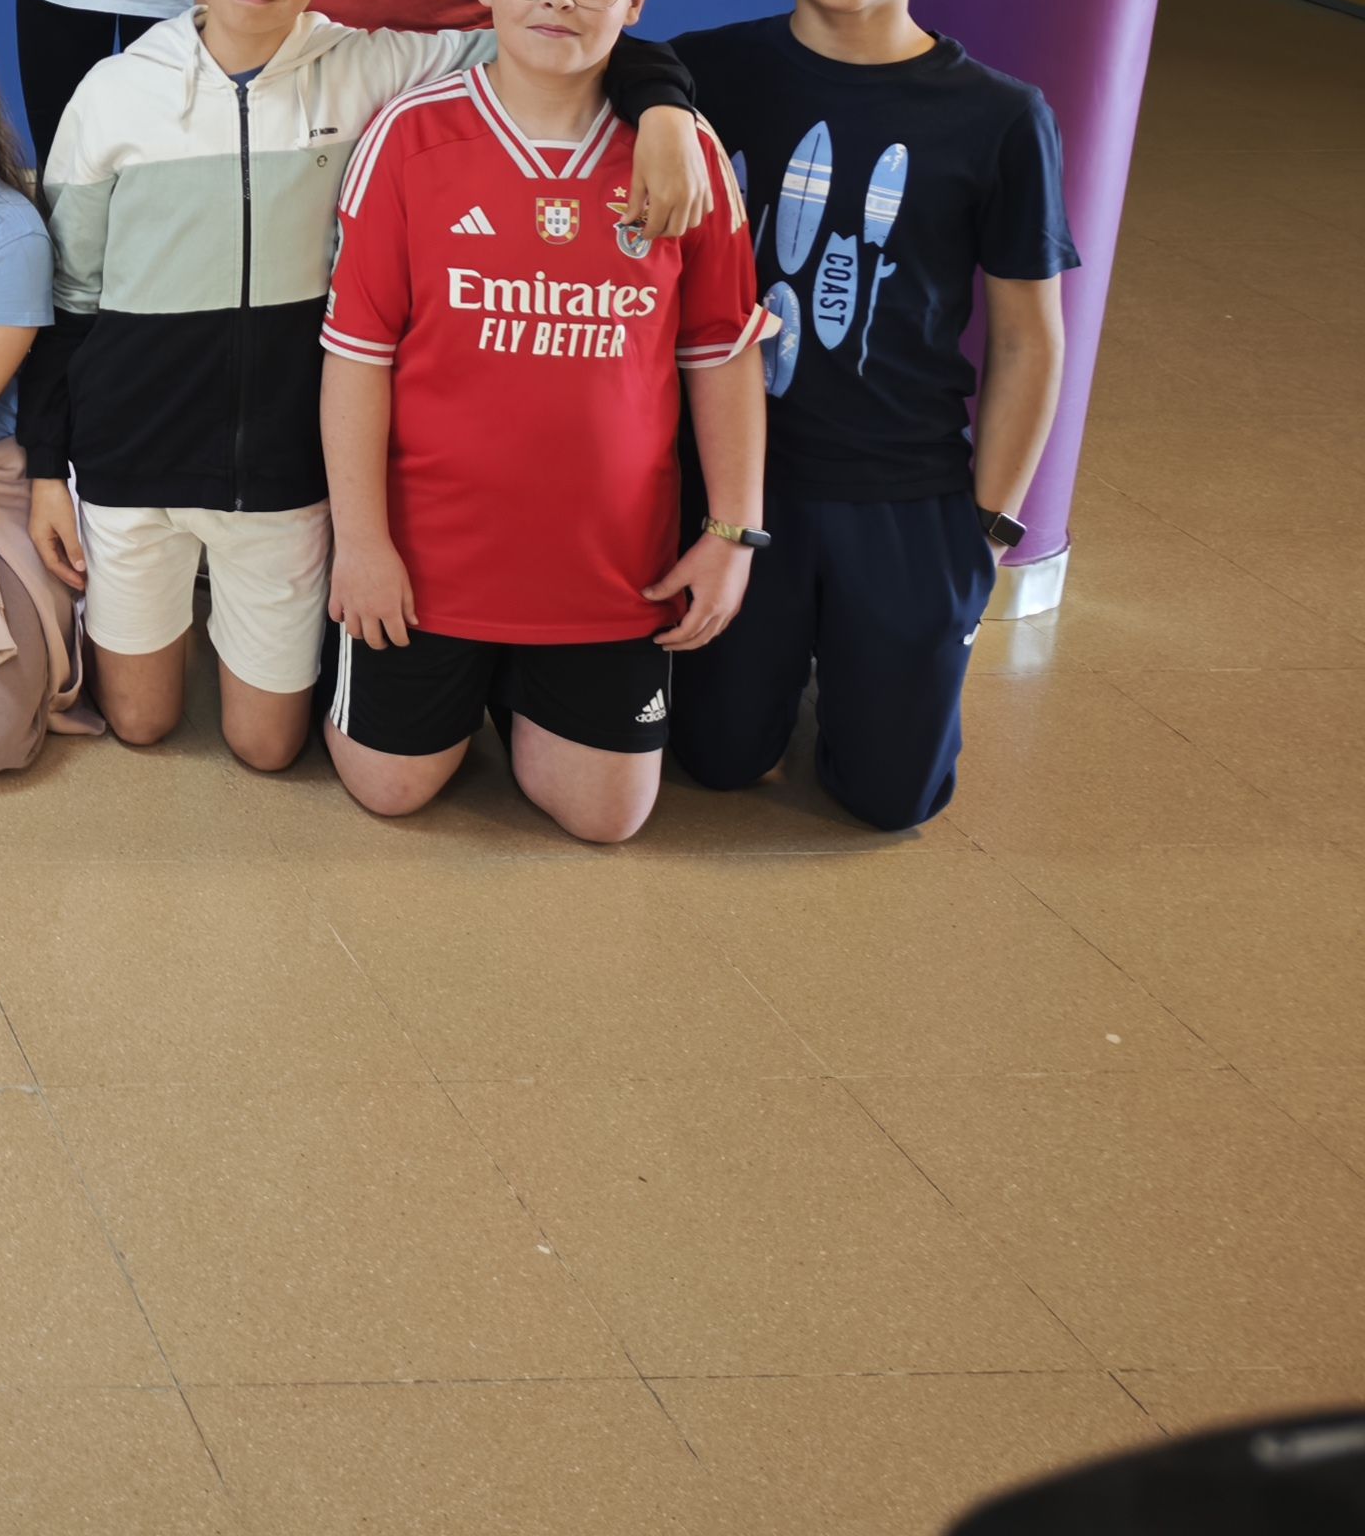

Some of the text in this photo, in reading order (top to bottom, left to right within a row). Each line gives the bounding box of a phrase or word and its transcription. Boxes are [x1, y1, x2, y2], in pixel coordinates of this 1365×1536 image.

[447, 267, 659, 318] Emirates
[817, 252, 854, 327] COAST
[478, 317, 626, 359] FLY BETTER
